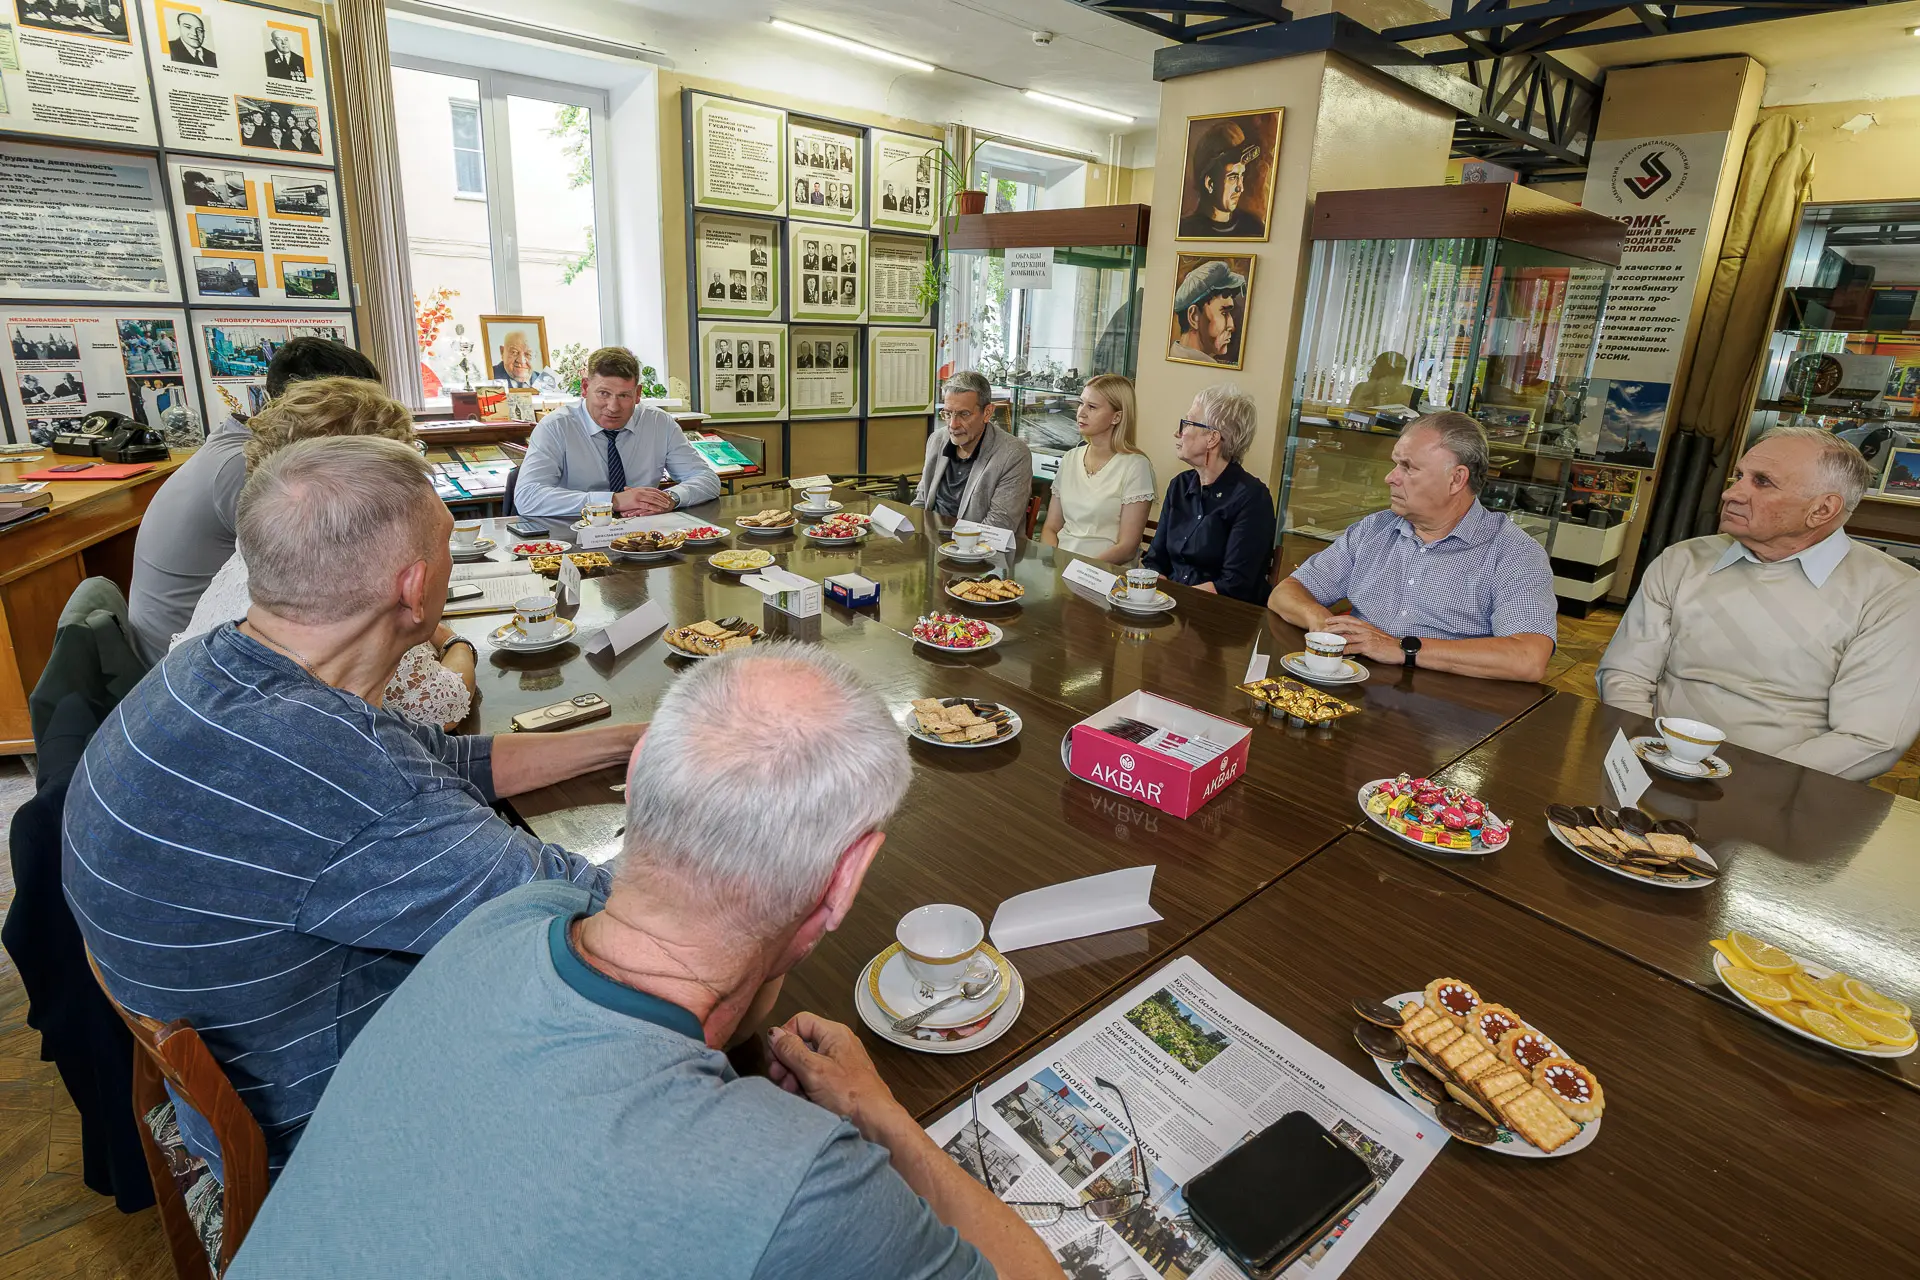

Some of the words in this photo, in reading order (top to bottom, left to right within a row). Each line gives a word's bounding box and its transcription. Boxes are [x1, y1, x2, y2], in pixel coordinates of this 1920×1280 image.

[48, 159, 113, 171] деятельность
[1665, 172, 1689, 202] КОМБИНАТ
[1626, 227, 1651, 236] ШИЙ
[1622, 284, 1678, 293] комбинату
[1595, 352, 1631, 361] ОССИИ.
[1605, 344, 1670, 353] промышлен-
[1091, 762, 1161, 803] AKBAR
[1202, 762, 1237, 800] AKBAR
[1104, 1026, 1129, 1048] среди
[1127, 1045, 1166, 1077] лучших!
[1173, 978, 1199, 999] Будет
[1199, 998, 1232, 1025] больше
[1231, 1020, 1280, 1057] деревьев
[1284, 1058, 1326, 1091] газонов
[1111, 1021, 1162, 1065] Спортсмены
[1163, 1061, 1189, 1086] ЧЭМК
[1052, 1061, 1095, 1104] Стройки
[1093, 1101, 1135, 1137] разных
